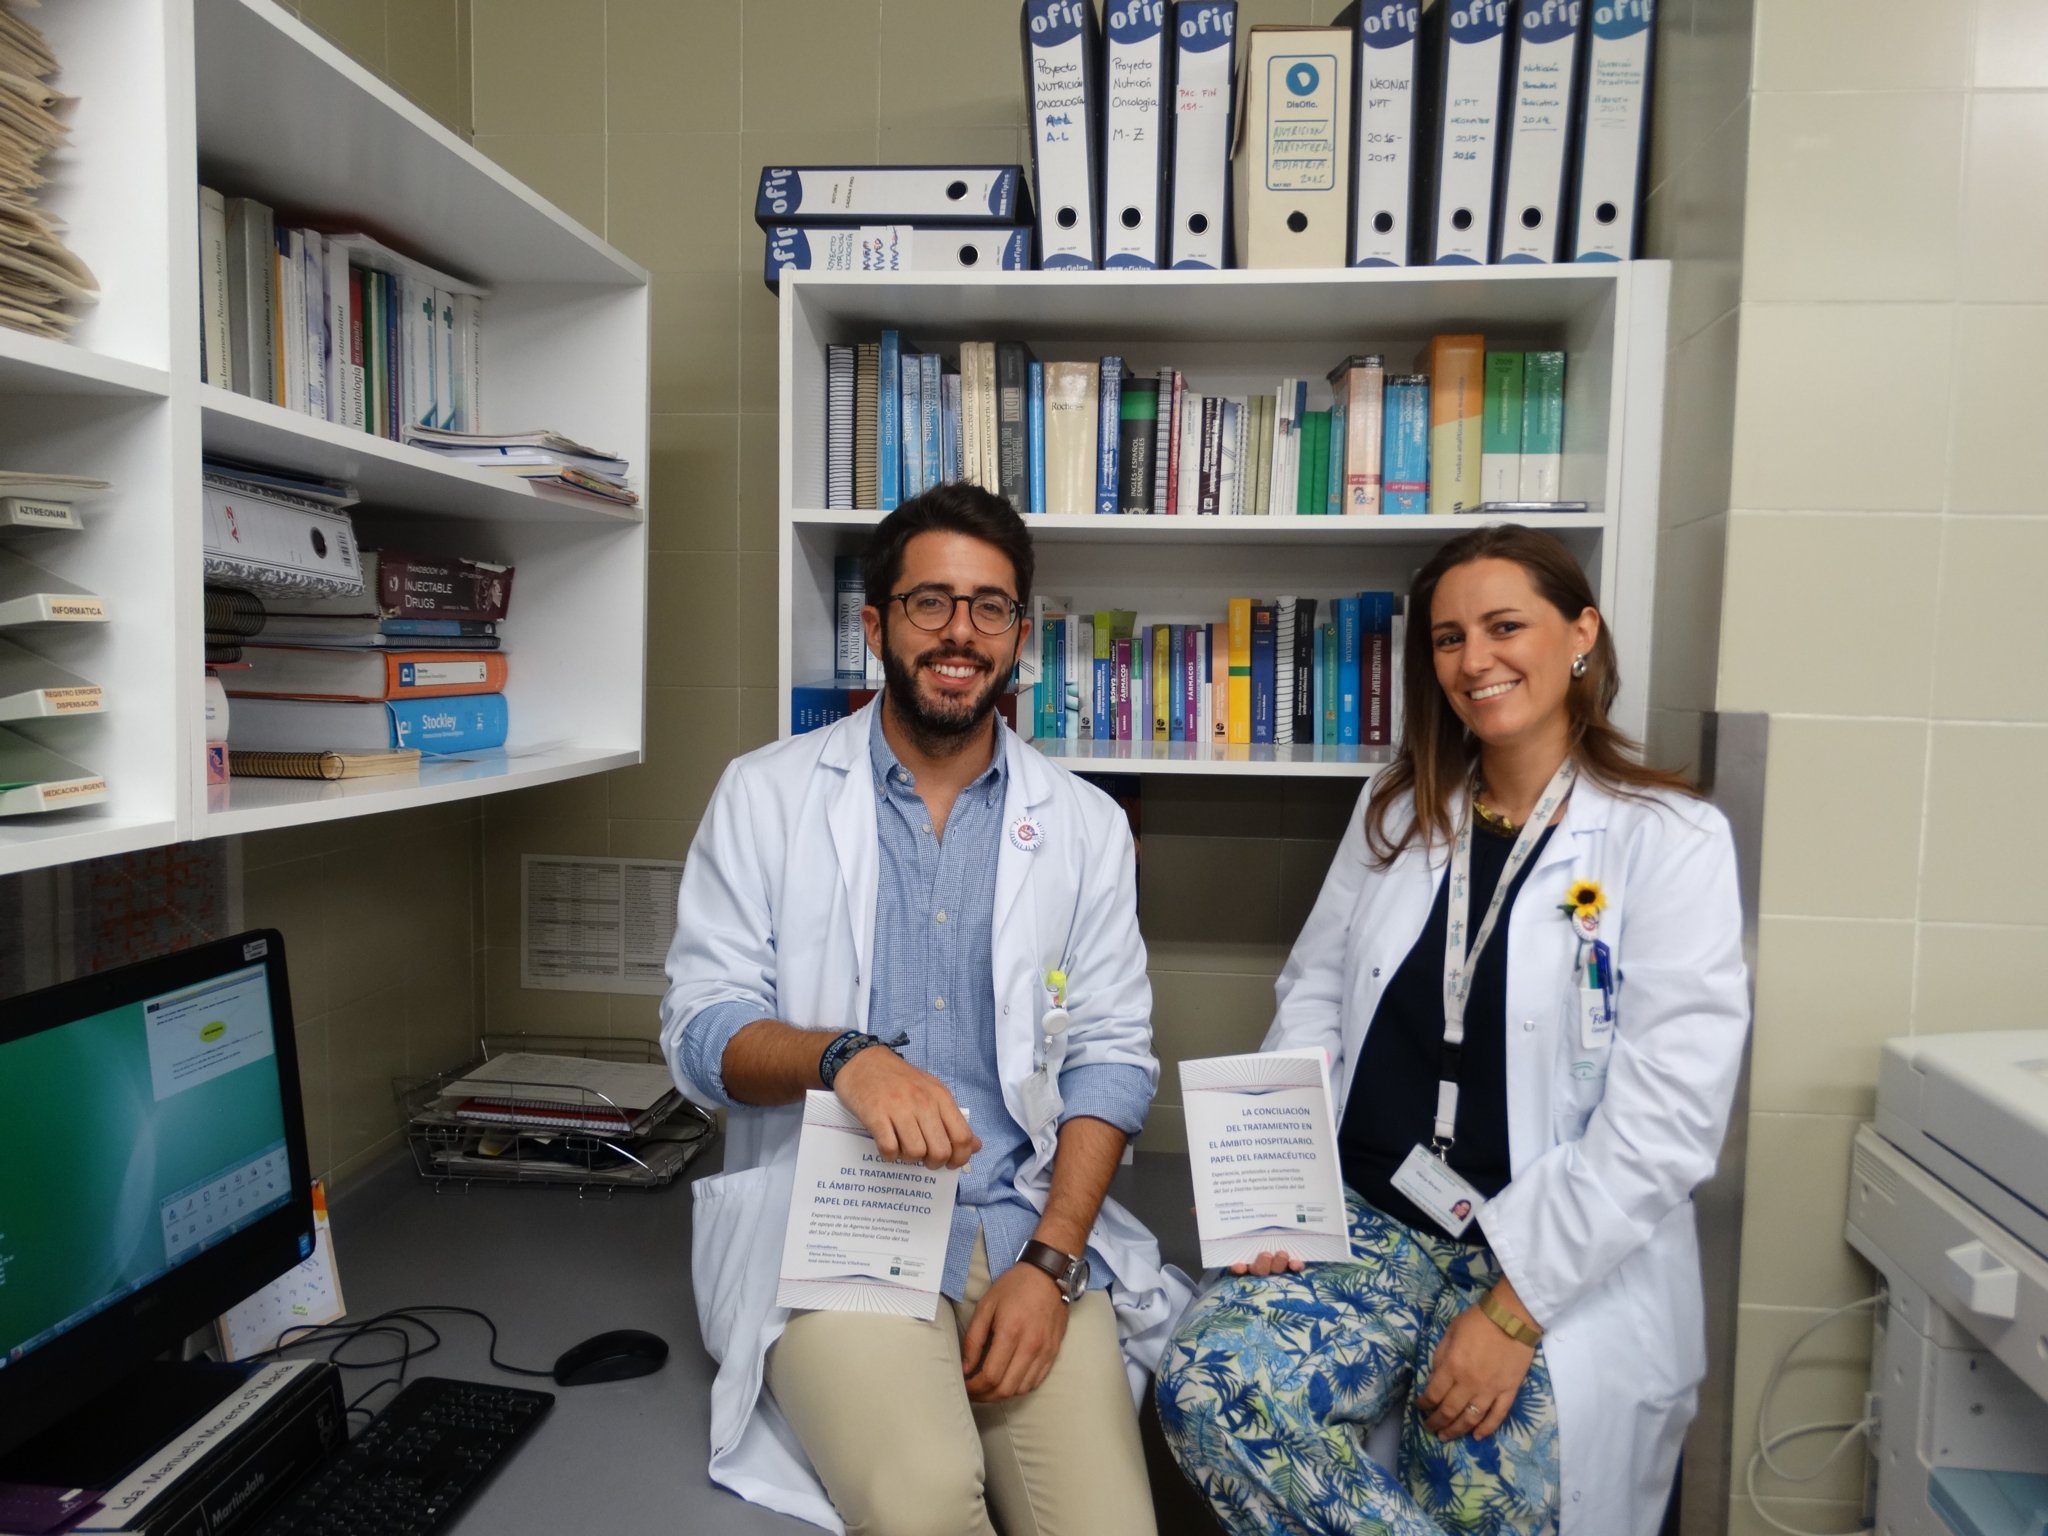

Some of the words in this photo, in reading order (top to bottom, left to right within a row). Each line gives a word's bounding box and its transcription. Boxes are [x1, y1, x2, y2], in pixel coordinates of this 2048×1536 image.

[1035, 58, 1077, 78] Proyecto
[1112, 57, 1153, 73] Proyecto
[340, 366, 348, 425] Sobrepeso
[352, 366, 363, 427] hepatología
[904, 366, 913, 441] Pharmacokinetics
[923, 366, 933, 441] Pharmacokinetics
[884, 369, 894, 446] Pharmacokinetics
[19, 505, 67, 519] AZTREONAM
[404, 577, 454, 595] INJECTABLE
[404, 594, 436, 609] DRUGS
[1345, 604, 1355, 612] 16
[51, 606, 102, 617] INFORMATICA
[840, 603, 849, 660] TRATAMIENTO
[850, 597, 861, 666] ANTIMICROBIANO
[1345, 617, 1353, 663] MEDIMECUM
[1371, 640, 1381, 695] PHARMACOTHERAPY
[45, 689, 74, 699] REGISTRO
[74, 688, 102, 696] ERRORES
[56, 700, 99, 710] DISPENSACION
[1370, 697, 1380, 727] HANDBOOK
[422, 713, 457, 731] Stockley
[43, 787, 80, 798] MEDICACION
[79, 782, 107, 793] URGENTE
[1242, 1109, 1252, 1117] LA
[1254, 1106, 1310, 1116] CONCILIACIÓN
[1243, 1122, 1299, 1131] TRATAMIENTO
[1301, 1122, 1312, 1130] EN
[1209, 1141, 1218, 1149] EL
[1220, 1138, 1253, 1149] ÁMBITO
[1255, 1137, 1314, 1146] HOSPITALARIO.
[862, 1153, 874, 1163] LA
[1210, 1155, 1234, 1164] PAPEL
[1236, 1154, 1252, 1162] DEL
[1253, 1151, 1316, 1161] FARMACÉUTICO
[840, 1167, 856, 1176] DEL
[859, 1170, 922, 1183] TRATAMIENTO
[924, 1176, 936, 1185] EN
[817, 1181, 827, 1189] EL
[829, 1180, 865, 1192] ÁMBITO
[867, 1186, 933, 1200] HOSPITALARIO.
[814, 1196, 841, 1206] PAPEL
[843, 1198, 859, 1207] DEL
[861, 1199, 931, 1214] FARMACÉUTICO
[843, 1214, 871, 1223] protocolos
[876, 1216, 908, 1226] documentos
[849, 1223, 870, 1231] Agencia
[871, 1225, 894, 1233] Sanitaria
[111, 1485, 150, 1511] Lda.
[142, 1438, 205, 1484] Manuela
[197, 1400, 251, 1443] Moreno
[256, 1365, 294, 1390] María
[212, 1472, 266, 1527] Martindale
